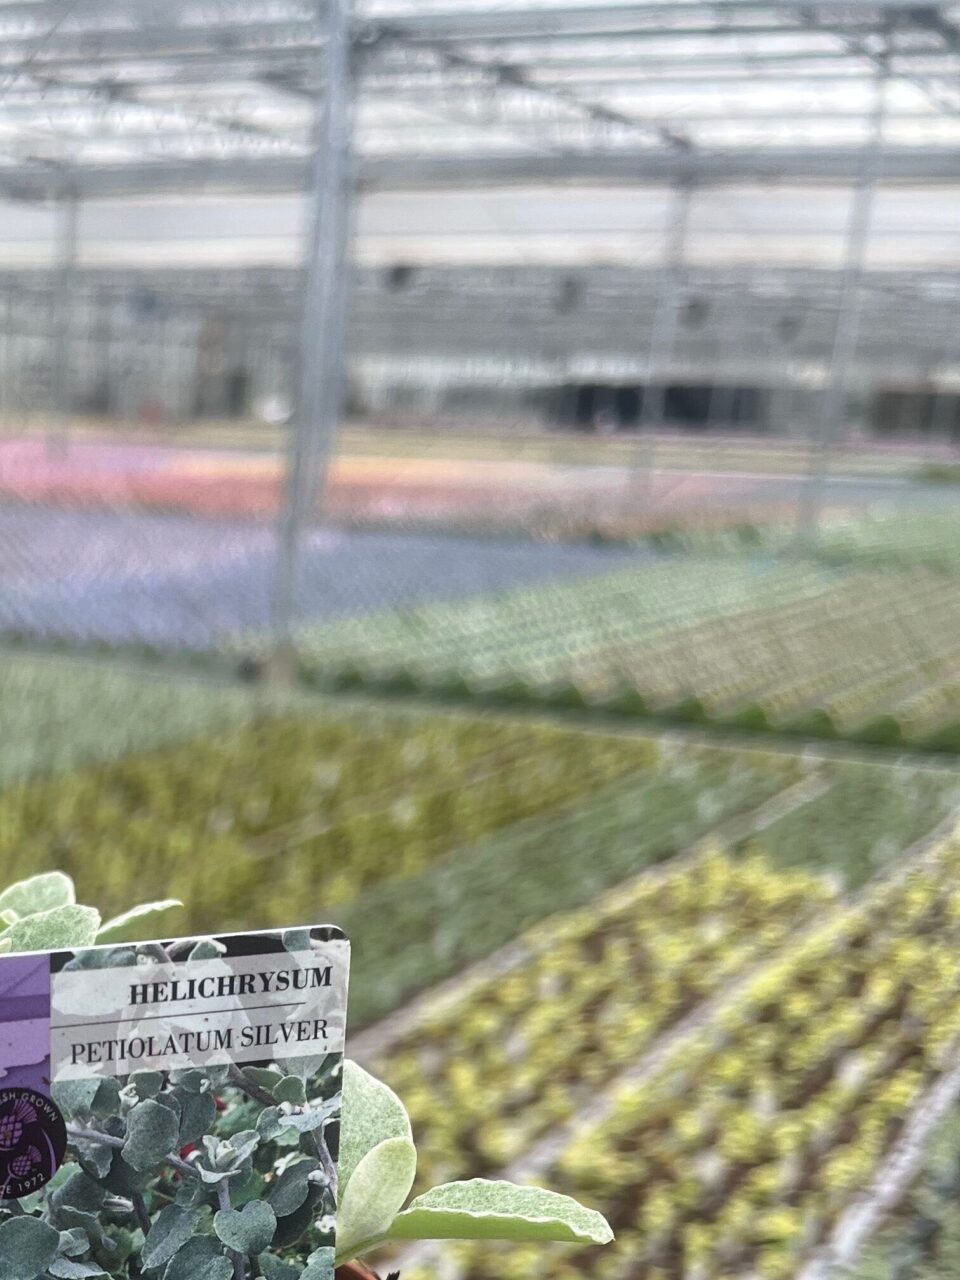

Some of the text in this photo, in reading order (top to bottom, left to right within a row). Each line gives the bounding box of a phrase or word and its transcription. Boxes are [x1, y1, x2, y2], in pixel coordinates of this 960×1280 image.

[129, 966, 333, 1006] HELICHRYSUM
[70, 1018, 330, 1065] PETIOLATUM SILVER
[20, 1092, 59, 1122] GROWN
[18, 1173, 45, 1192] 1972
